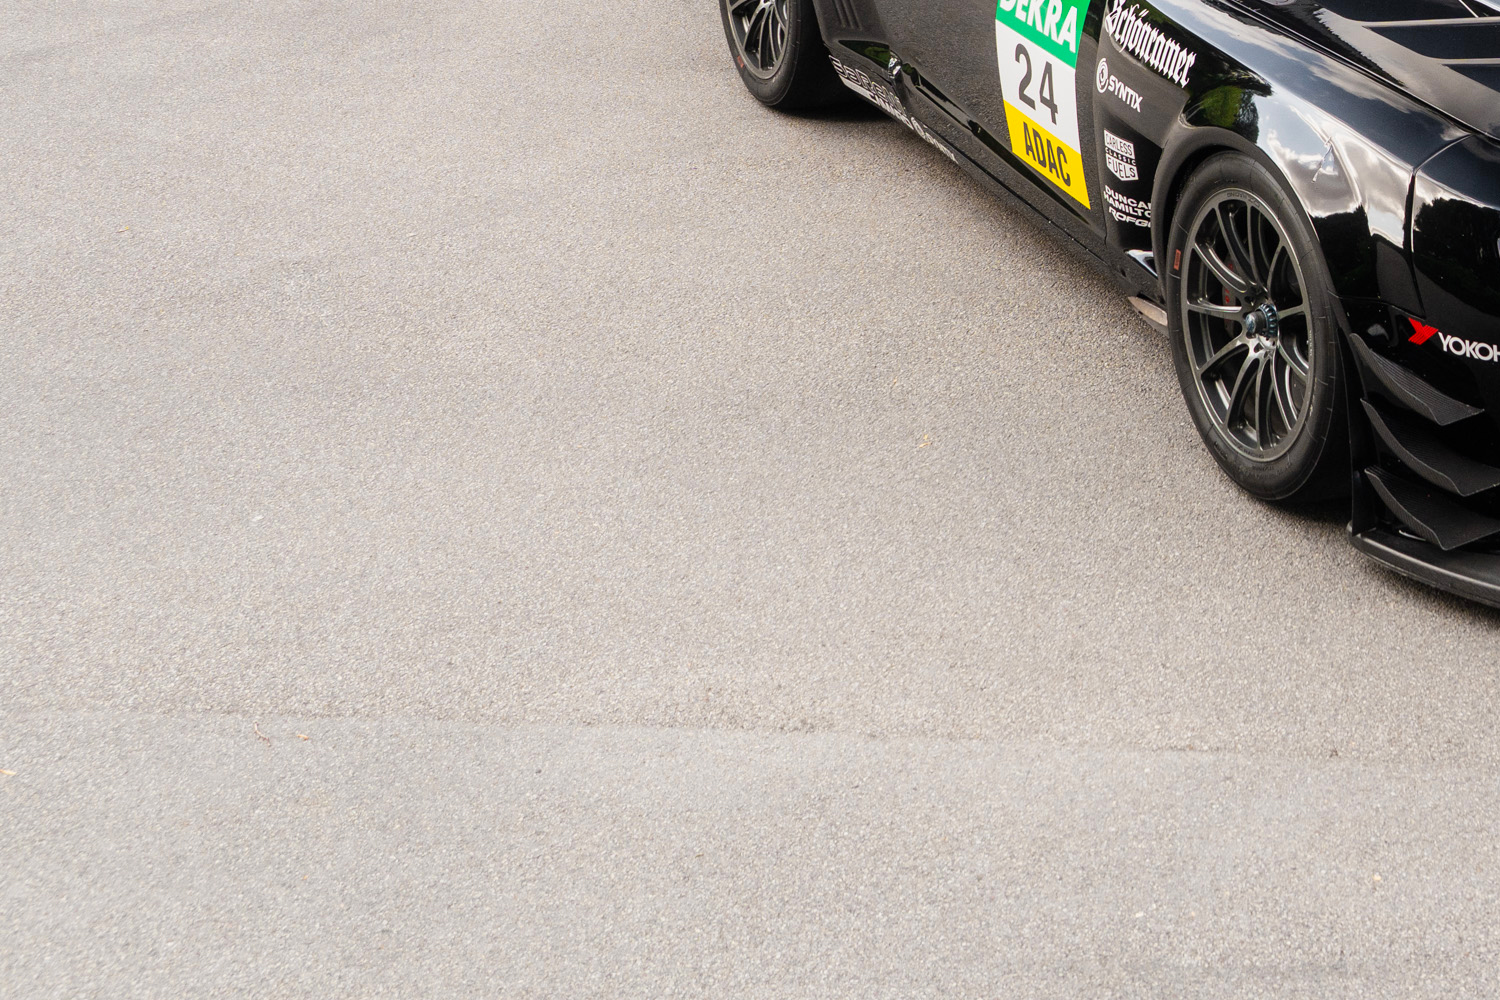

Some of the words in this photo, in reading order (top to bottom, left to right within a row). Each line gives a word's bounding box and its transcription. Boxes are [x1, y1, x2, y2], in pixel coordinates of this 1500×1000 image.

[1015, 43, 1058, 125] 24
[1108, 75, 1143, 112] SYNTIX
[1023, 121, 1071, 187] ADAC
[1105, 146, 1137, 166] CLASSIC
[1107, 157, 1136, 179] FUELS
